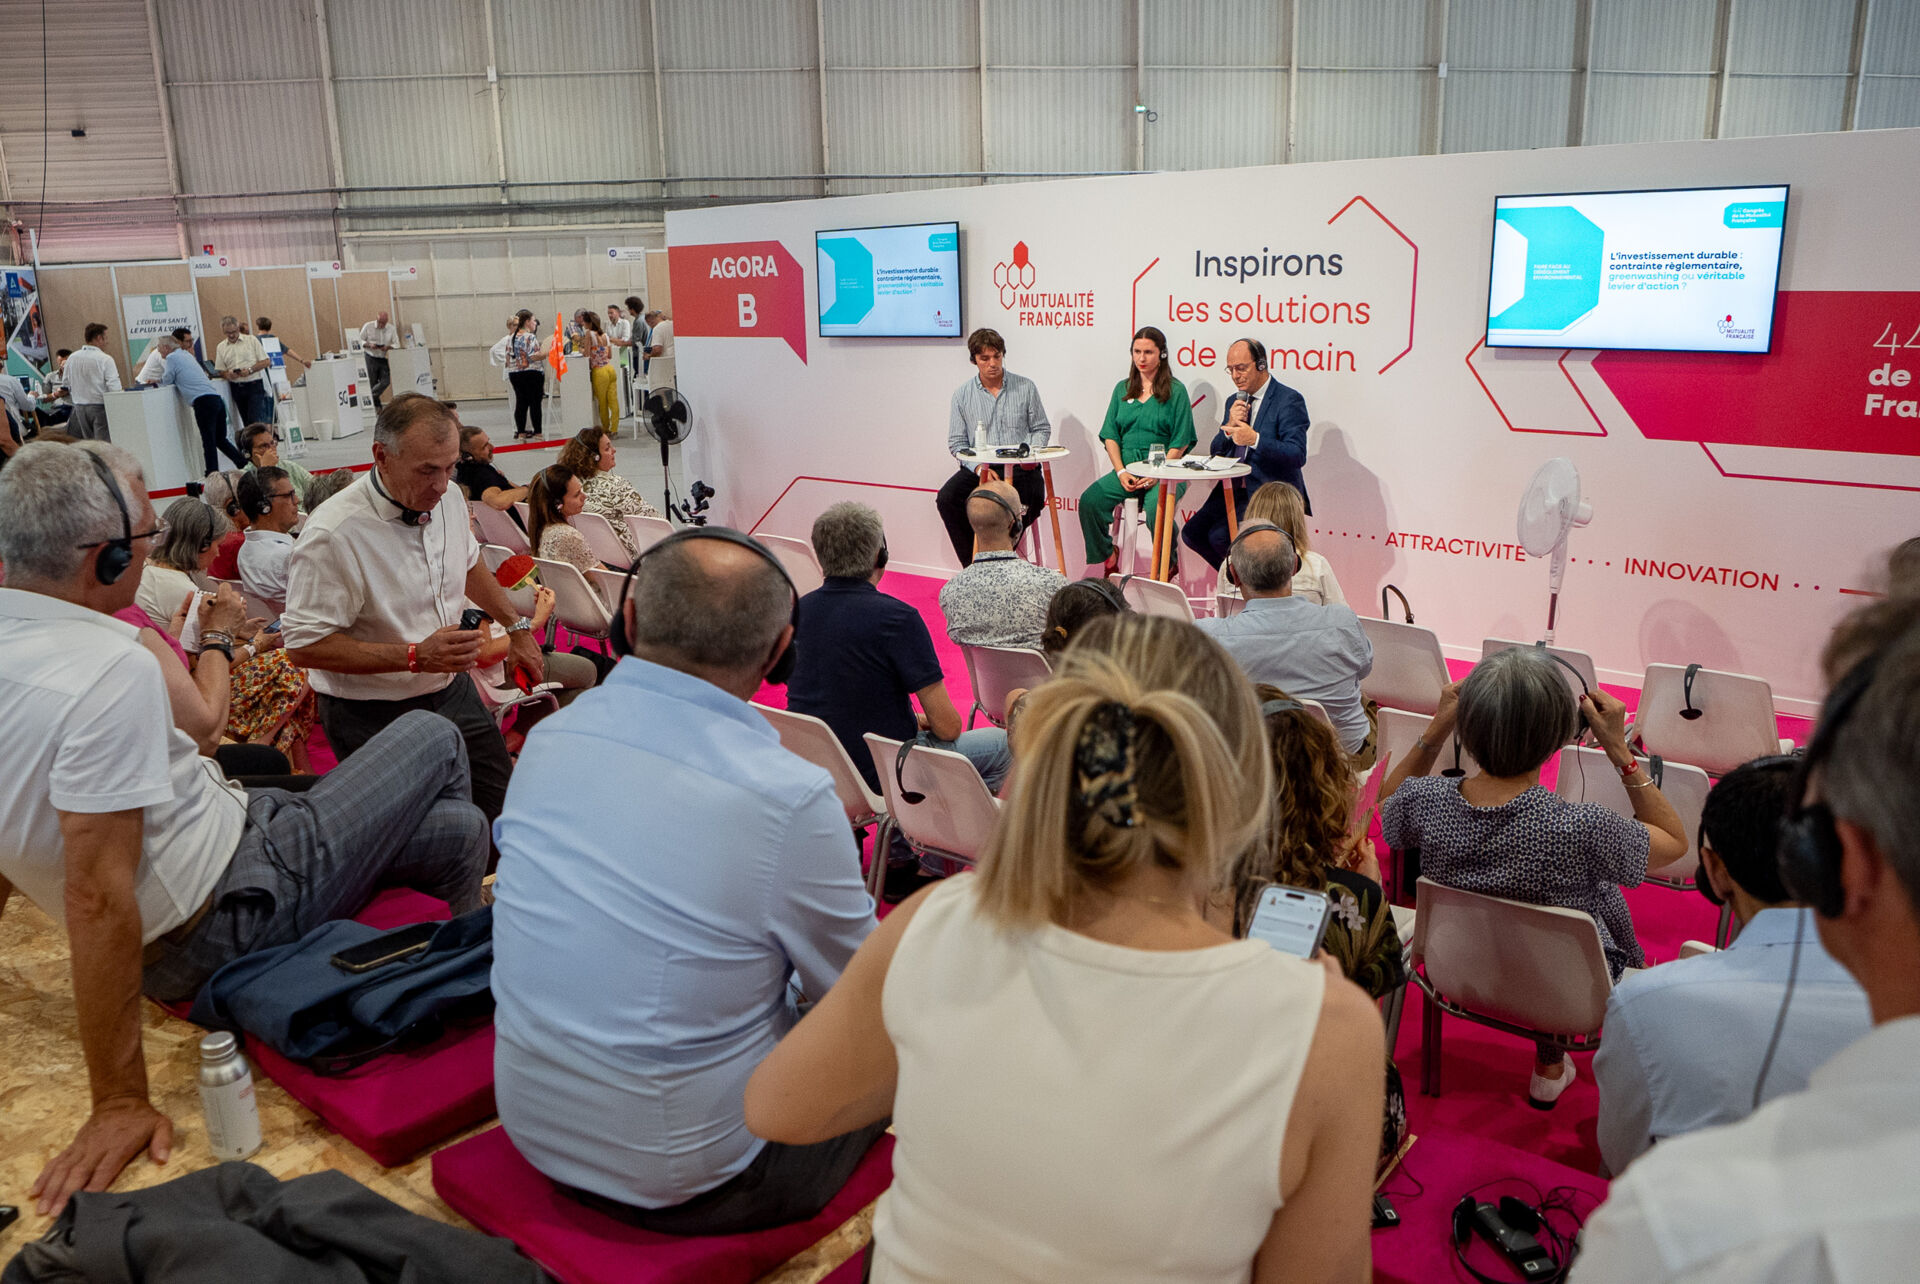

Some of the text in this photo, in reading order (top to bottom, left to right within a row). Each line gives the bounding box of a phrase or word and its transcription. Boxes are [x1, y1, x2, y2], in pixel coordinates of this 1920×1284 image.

[709, 255, 779, 279] AGORA
[1195, 246, 1343, 284] Inspirons
[1610, 261, 1663, 270] contrainte
[1611, 251, 1695, 260] L'investissement
[1697, 250, 1738, 260] durable
[1608, 271, 1680, 282] greenwashing
[1608, 281, 1636, 290] levier
[1637, 281, 1680, 290] d'action
[737, 293, 759, 328] B
[1019, 289, 1095, 308] MUTUALITÉ
[1168, 293, 1371, 325] les solutions
[139, 326, 157, 334] PLUS
[1019, 311, 1094, 330] FRANÇAISE
[1176, 338, 1357, 373] de main
[1868, 363, 1911, 387] de
[1864, 393, 1920, 418] Fra
[1624, 557, 1780, 592] INNOVATION
